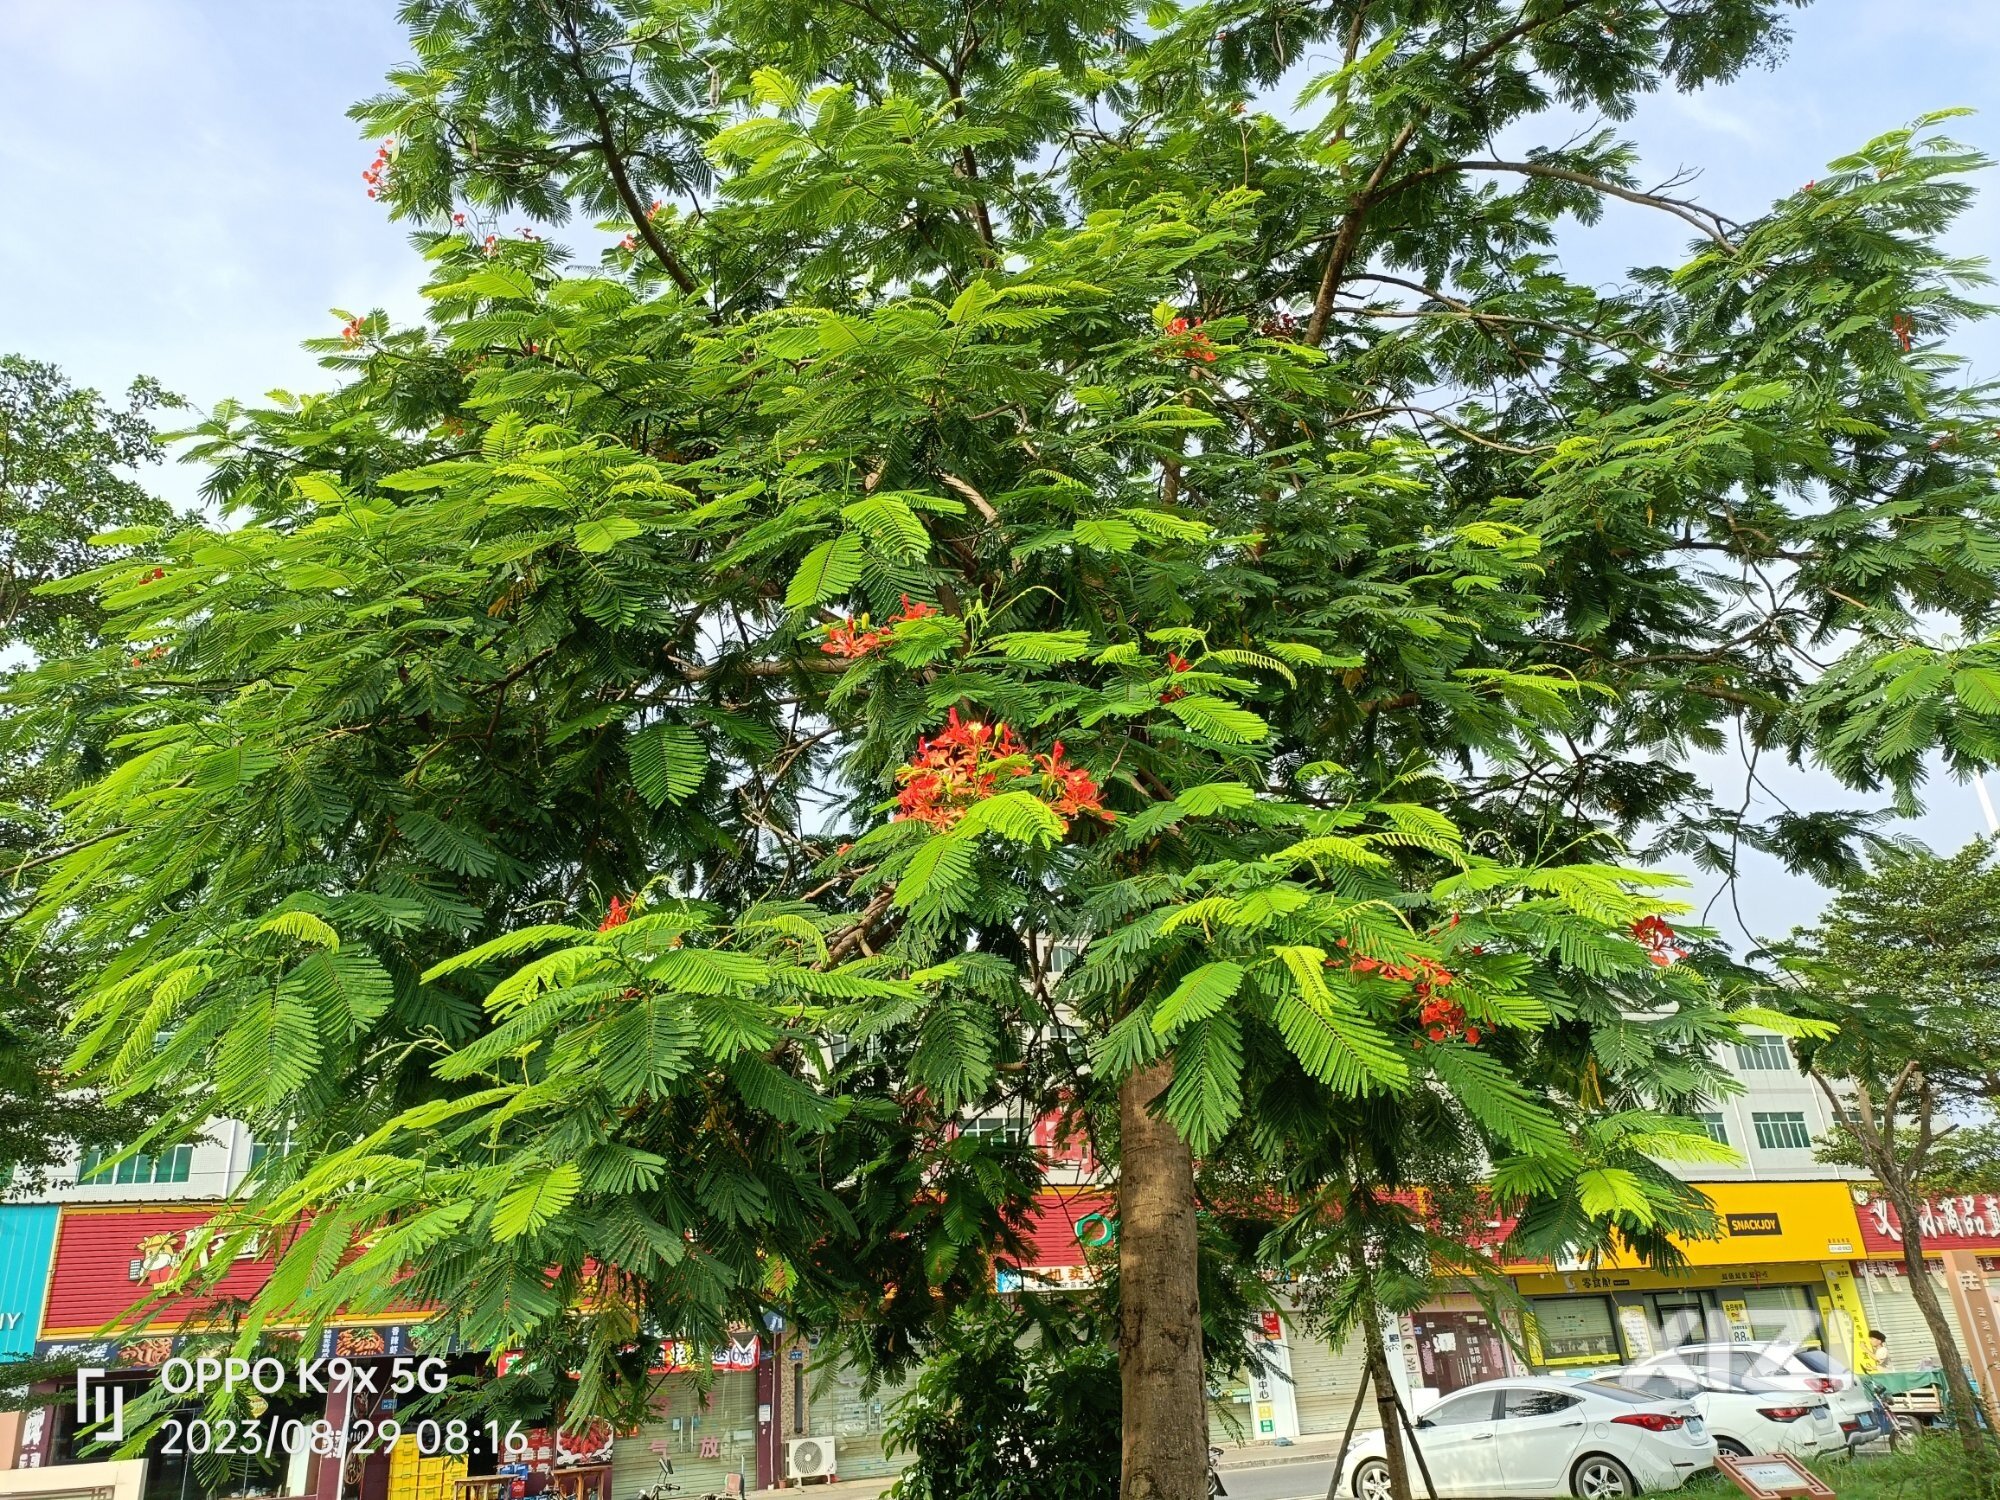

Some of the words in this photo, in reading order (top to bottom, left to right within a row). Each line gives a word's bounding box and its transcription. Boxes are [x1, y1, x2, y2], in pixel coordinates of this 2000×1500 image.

[1869, 1195, 2000, 1242] 义小商品直
[1732, 1219, 1776, 1231] SNACKJOY
[1733, 1331, 1747, 1342] 88
